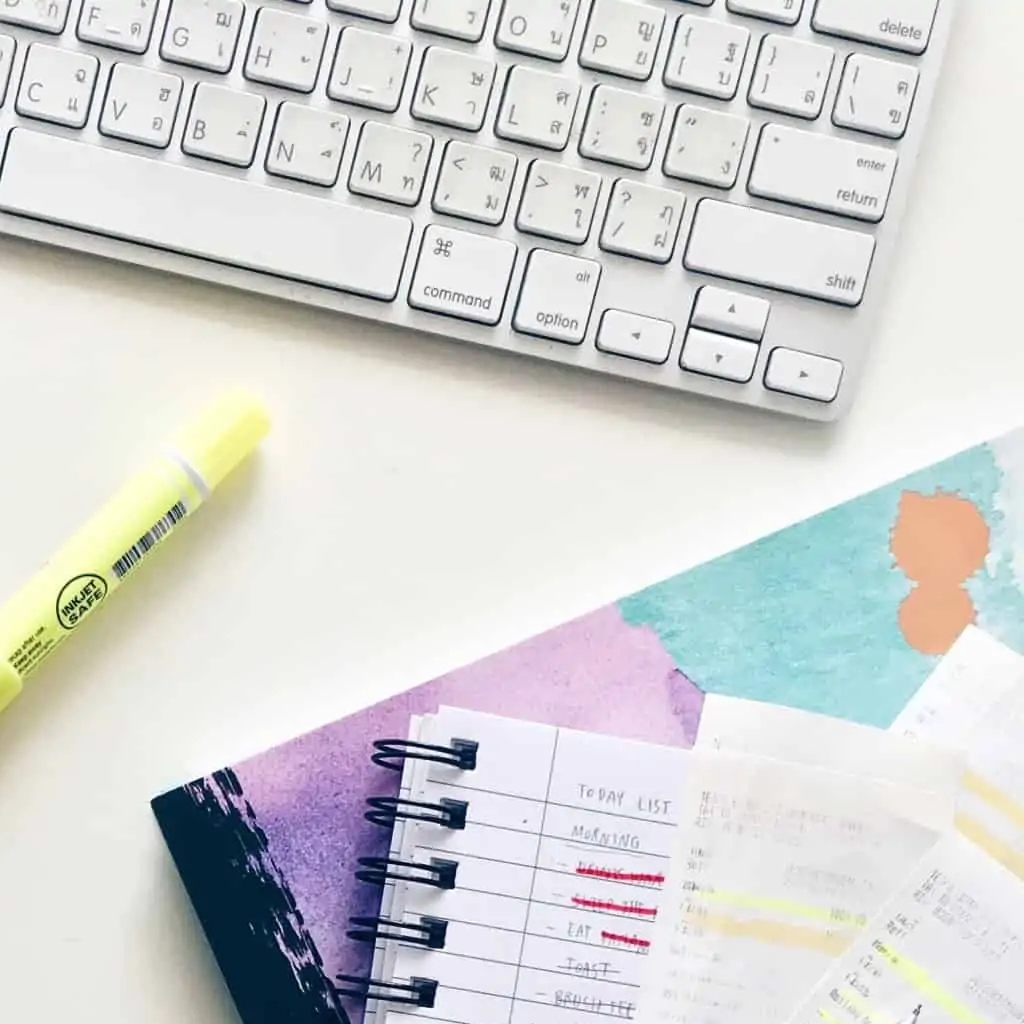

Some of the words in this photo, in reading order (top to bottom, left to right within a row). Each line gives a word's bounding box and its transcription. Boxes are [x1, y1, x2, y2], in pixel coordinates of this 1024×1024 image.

[88, 7, 101, 26] F
[510, 16, 527, 36] O
[173, 28, 189, 46] G
[879, 18, 922, 40] delete
[593, 35, 607, 53] P
[255, 46, 272, 68] H
[340, 67, 351, 86] J
[28, 82, 43, 102] C
[422, 86, 439, 106] K
[112, 100, 127, 121] V
[508, 104, 519, 125] L
[192, 120, 206, 140] B
[276, 141, 294, 163] N
[360, 161, 382, 182] M
[856, 158, 886, 171] enter
[836, 187, 878, 209] return
[576, 270, 590, 284] alt
[825, 272, 857, 292] shift
[423, 283, 492, 311] command
[535, 309, 578, 331] option
[61, 579, 97, 617] INKJET
[68, 588, 104, 625] SAFE
[638, 800, 672, 816] LIST
[571, 825, 640, 850] MORNING
[567, 922, 593, 938] EAT
[610, 999, 635, 1018] TEE
